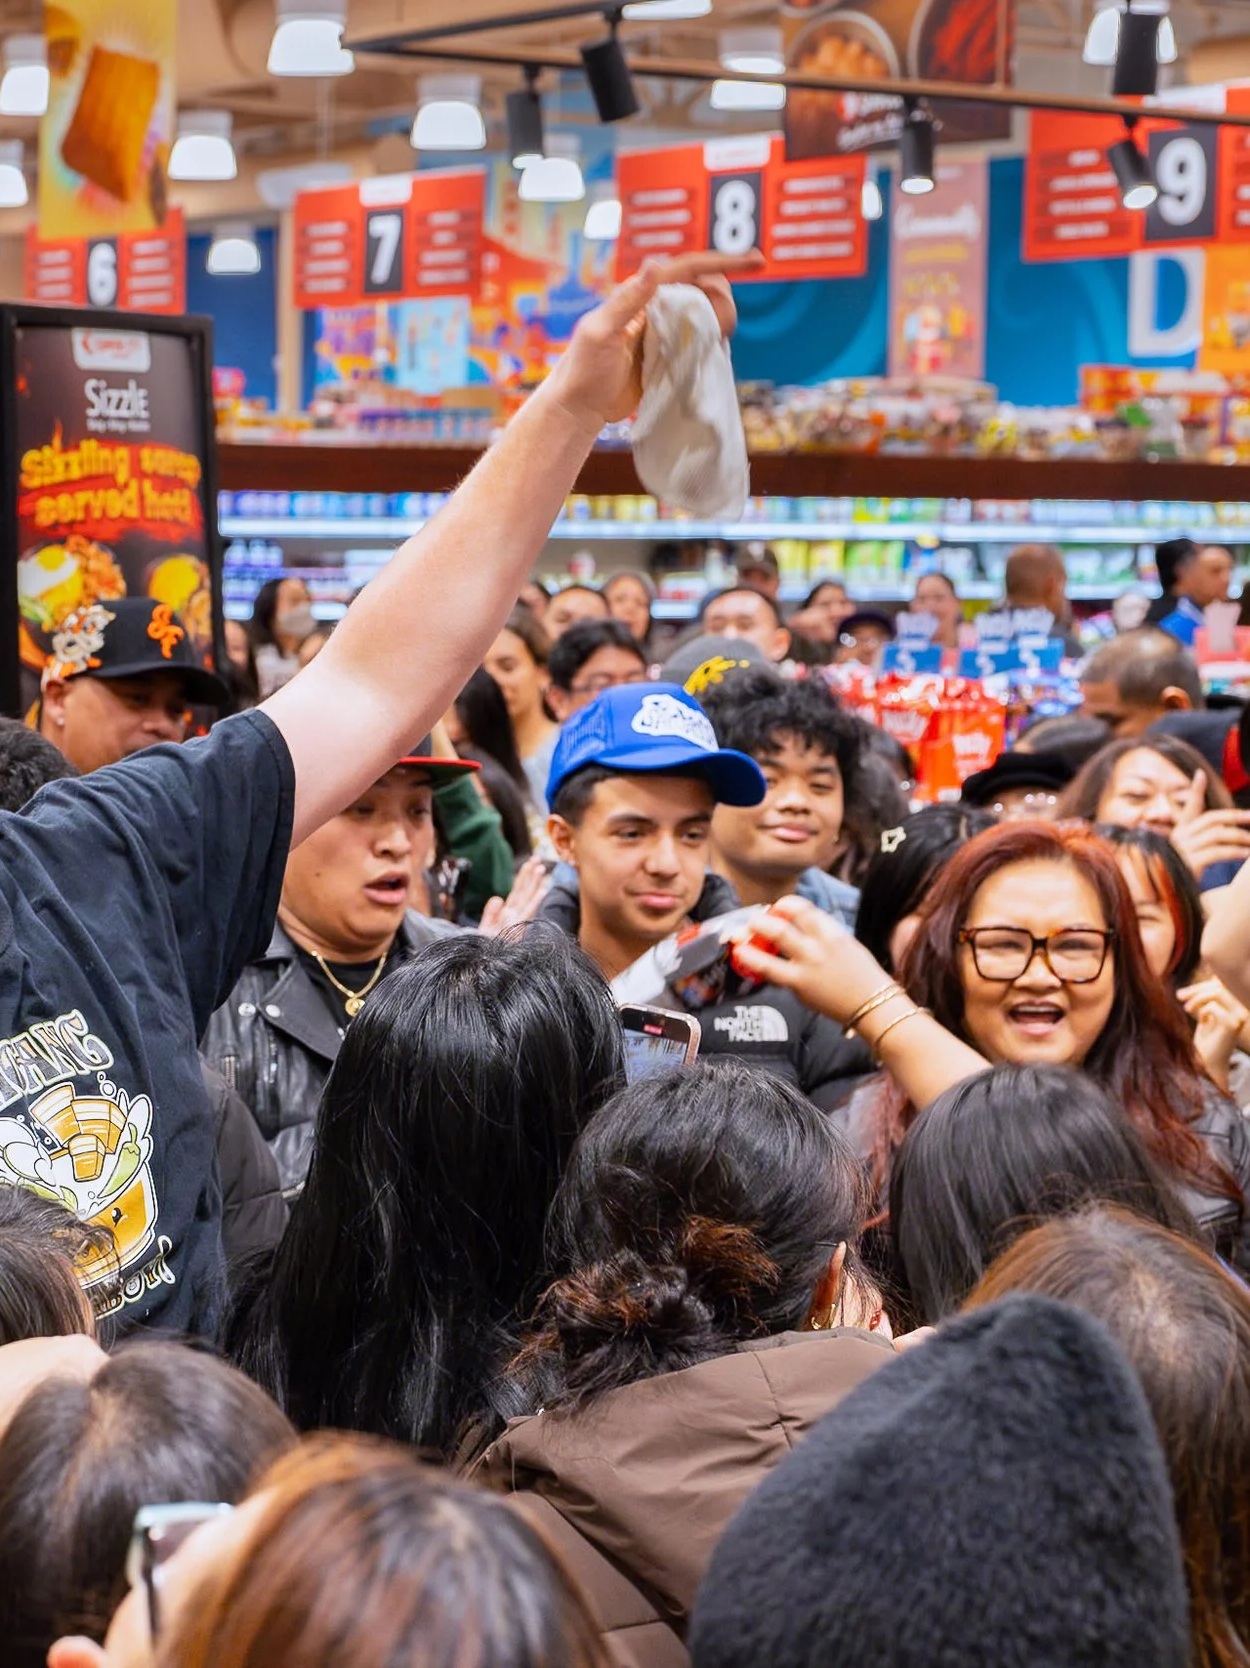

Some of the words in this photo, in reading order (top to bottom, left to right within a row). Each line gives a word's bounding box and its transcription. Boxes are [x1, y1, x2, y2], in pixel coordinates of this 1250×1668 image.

[1156, 137, 1207, 226] 9
[368, 214, 401, 284] 7
[713, 179, 756, 256] 8
[87, 242, 118, 307] 6
[1128, 249, 1206, 357] D
[714, 1016, 761, 1032] NORTH
[729, 1031, 761, 1042] FACE
[734, 1005, 761, 1018] THE
